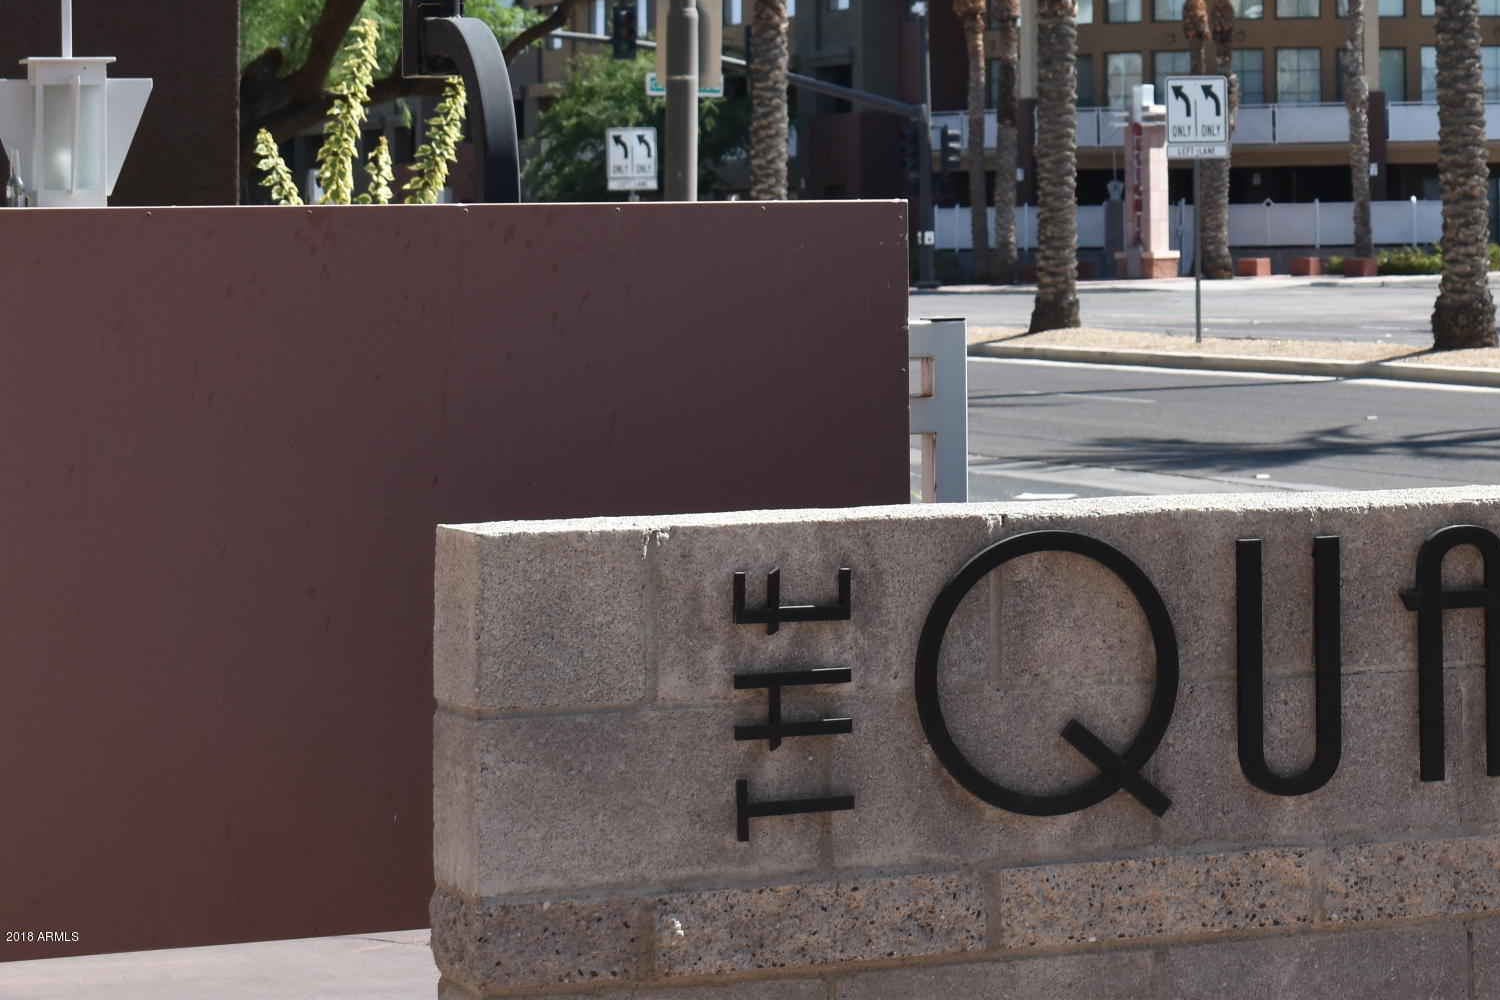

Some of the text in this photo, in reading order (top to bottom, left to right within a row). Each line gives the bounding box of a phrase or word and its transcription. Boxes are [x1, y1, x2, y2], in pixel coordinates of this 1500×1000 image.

[1172, 125, 1221, 137] ONLY ONLY
[1177, 147, 1216, 155] LEFT LANE
[612, 163, 652, 174] ONLY ONLY
[733, 567, 855, 842] THE
